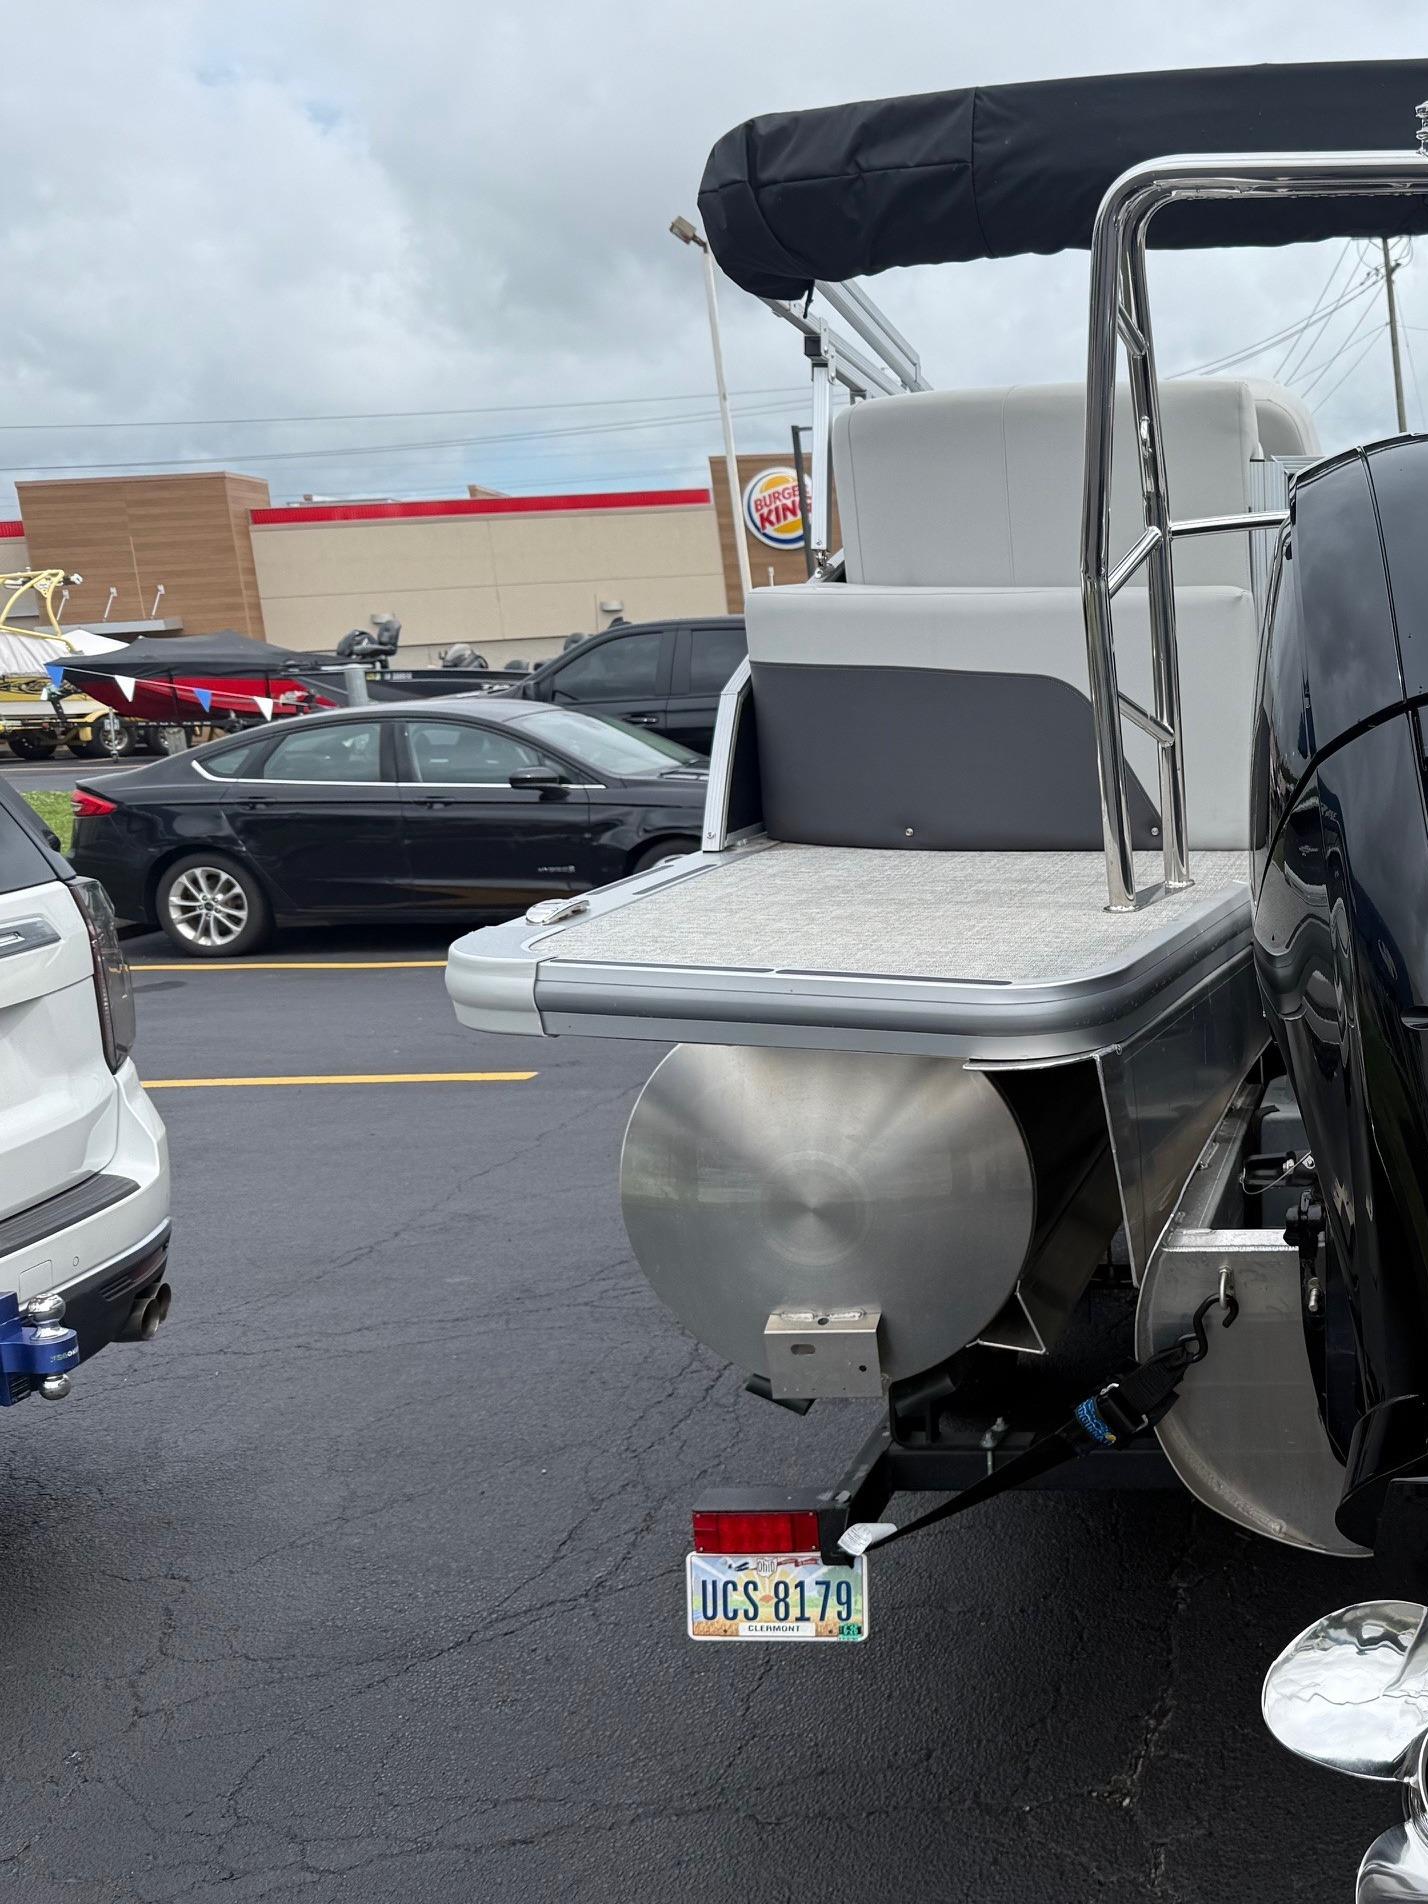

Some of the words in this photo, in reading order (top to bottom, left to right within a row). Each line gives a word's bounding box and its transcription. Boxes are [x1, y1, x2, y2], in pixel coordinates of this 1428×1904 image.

[754, 485, 803, 513] BURGE
[701, 1579, 759, 1621] UCS
[773, 1579, 853, 1622] 8179
[747, 1624, 801, 1633] CLERMONT
